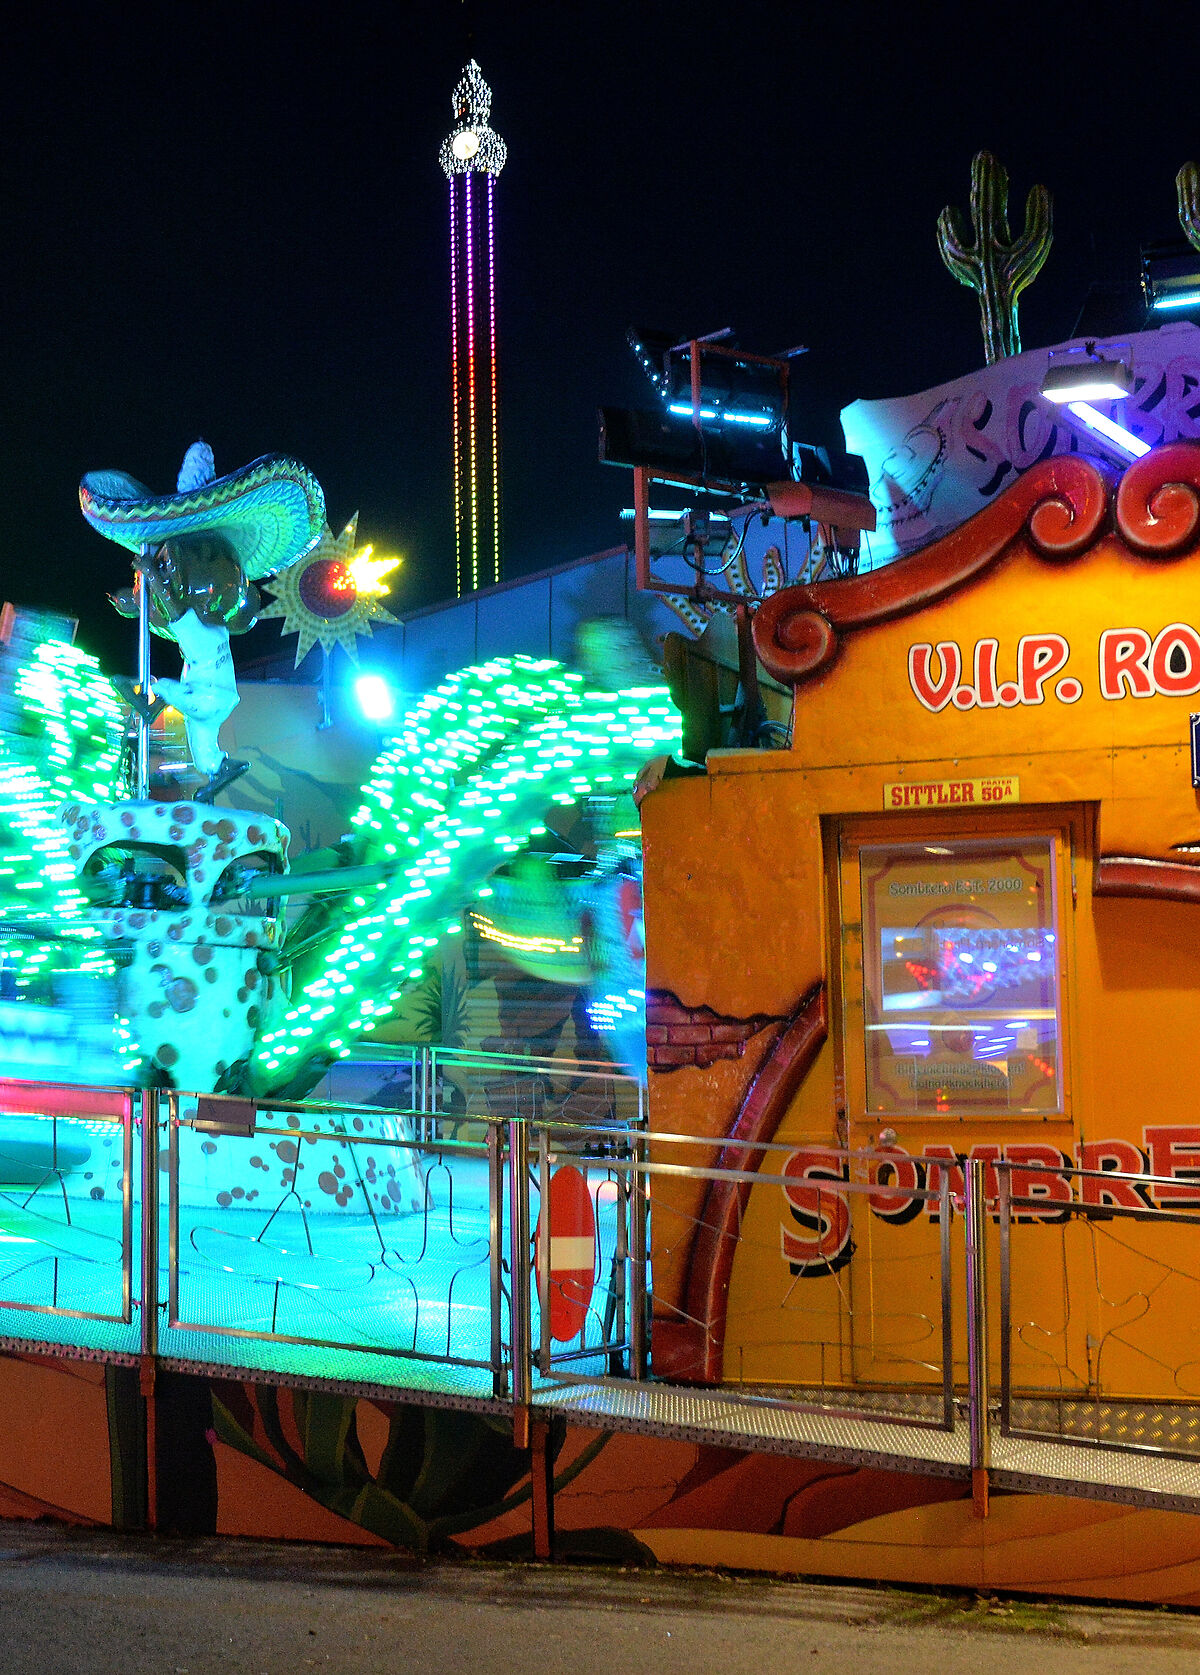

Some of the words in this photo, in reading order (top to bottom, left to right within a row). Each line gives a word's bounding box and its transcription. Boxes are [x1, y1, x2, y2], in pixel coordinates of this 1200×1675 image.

[908, 634, 1083, 713] V.I.P.
[891, 782, 974, 807] SITTLER
[987, 878, 1022, 893] 2000
